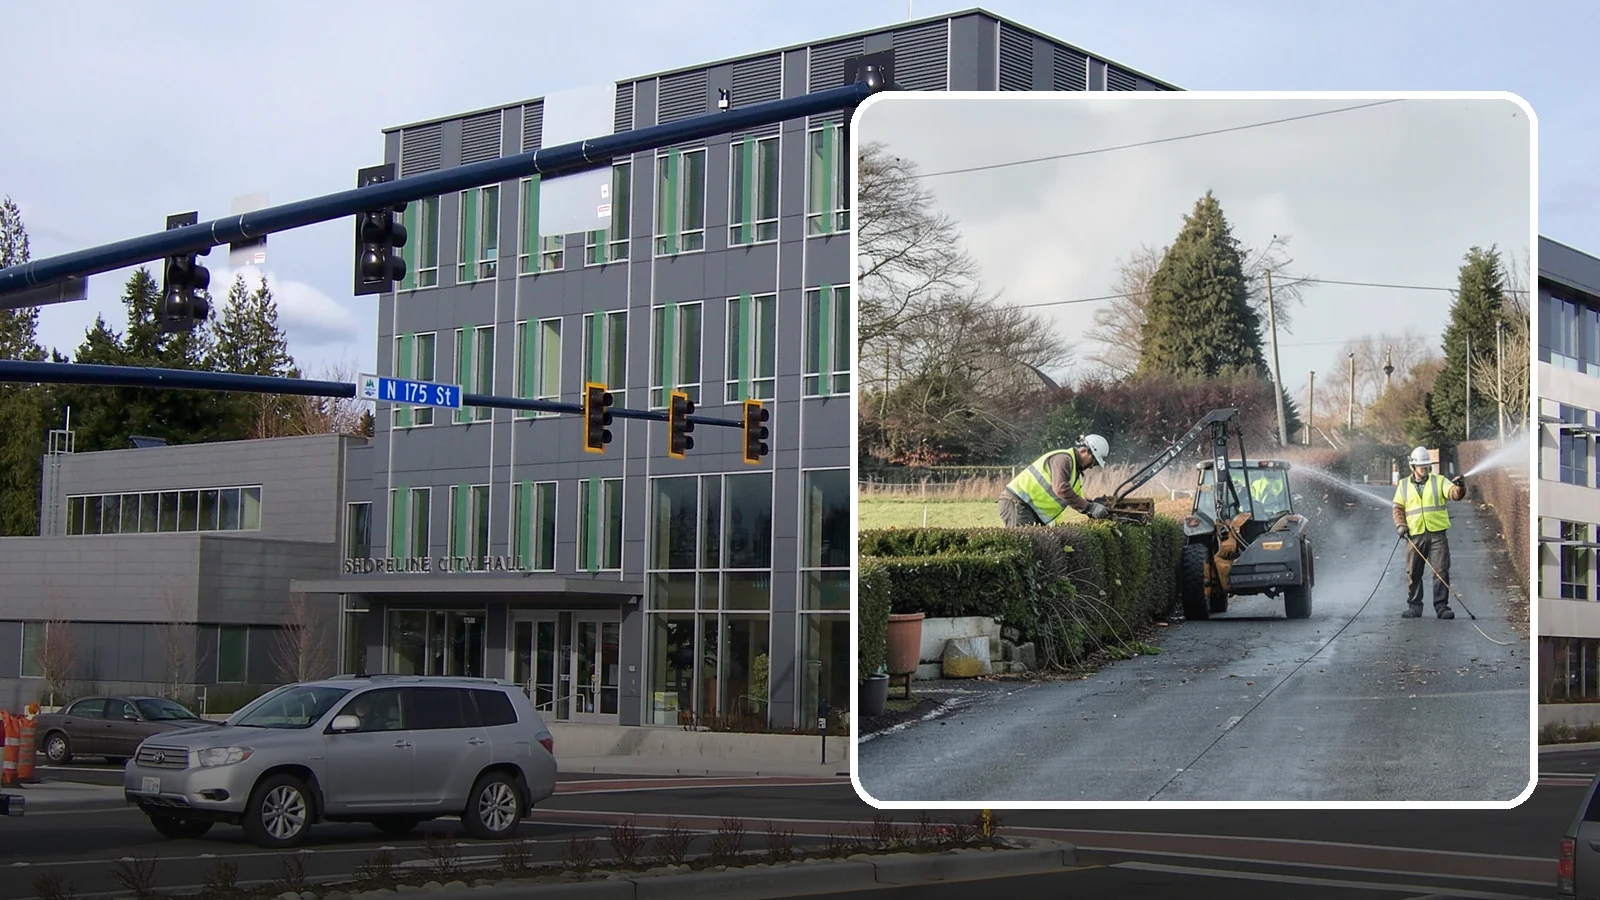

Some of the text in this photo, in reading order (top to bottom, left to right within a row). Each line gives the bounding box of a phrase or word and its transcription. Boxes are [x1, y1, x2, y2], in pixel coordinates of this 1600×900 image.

[387, 381, 451, 406] N 175 St
[344, 555, 526, 574] SHORELINE CITY HALL
